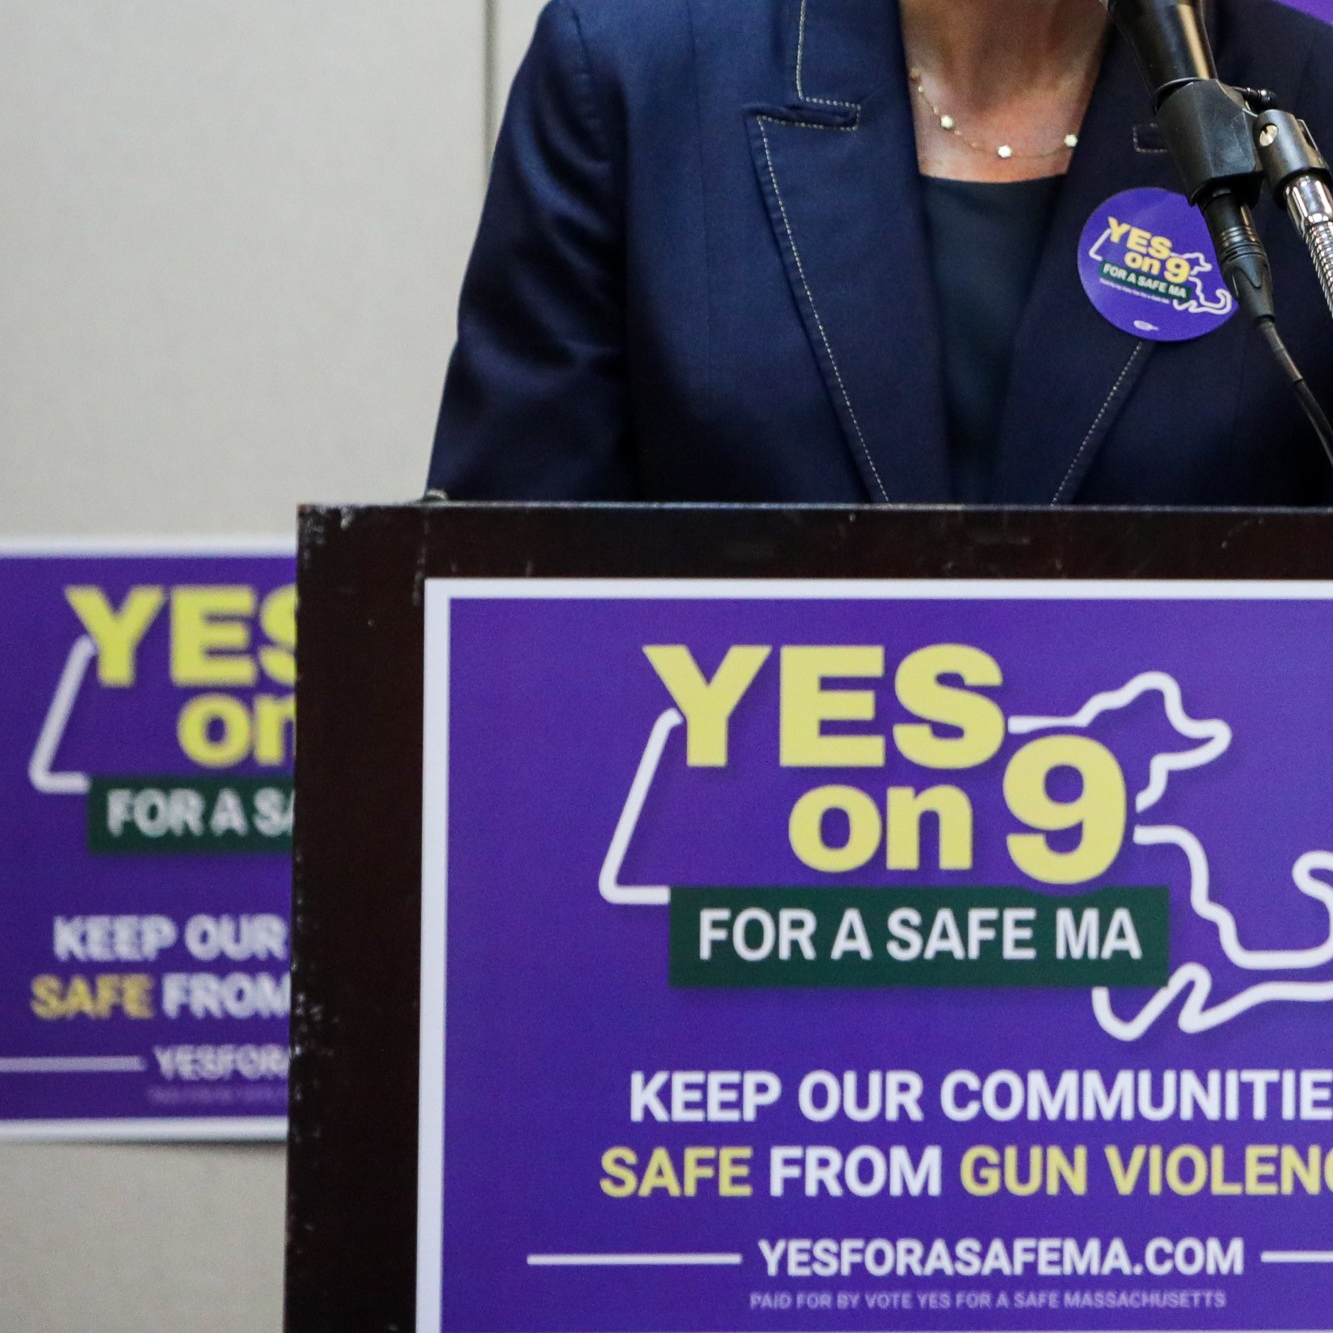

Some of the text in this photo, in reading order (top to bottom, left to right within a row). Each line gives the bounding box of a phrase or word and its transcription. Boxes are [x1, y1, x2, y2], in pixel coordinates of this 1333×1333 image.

[1108, 217, 1173, 260] YES
[1103, 264, 1127, 280] FOR
[1127, 272, 1137, 284] A
[1138, 276, 1168, 291] SAFE
[1168, 283, 1187, 298] MA
[1124, 252, 1190, 283] on 9
[642, 643, 1008, 769] YES
[106, 788, 205, 836] FOR
[209, 789, 248, 836] A
[788, 733, 1126, 885] on 9
[53, 914, 288, 961] KEEP OUR
[698, 908, 1142, 962] FOR A SAFE MA
[30, 974, 153, 1019] SAFE
[629, 1070, 781, 1124] KEEP
[798, 1070, 924, 1124] OUR
[598, 1147, 753, 1200] SAFE
[769, 1147, 941, 1198] FROM
[960, 1145, 1086, 1198] GUN
[758, 1237, 1244, 1276] YESFORASAFEMA.COM
[750, 1290, 1226, 1309] PAID FOR BY VOTE YES FOR A SAFE MASSACHUSETTS
